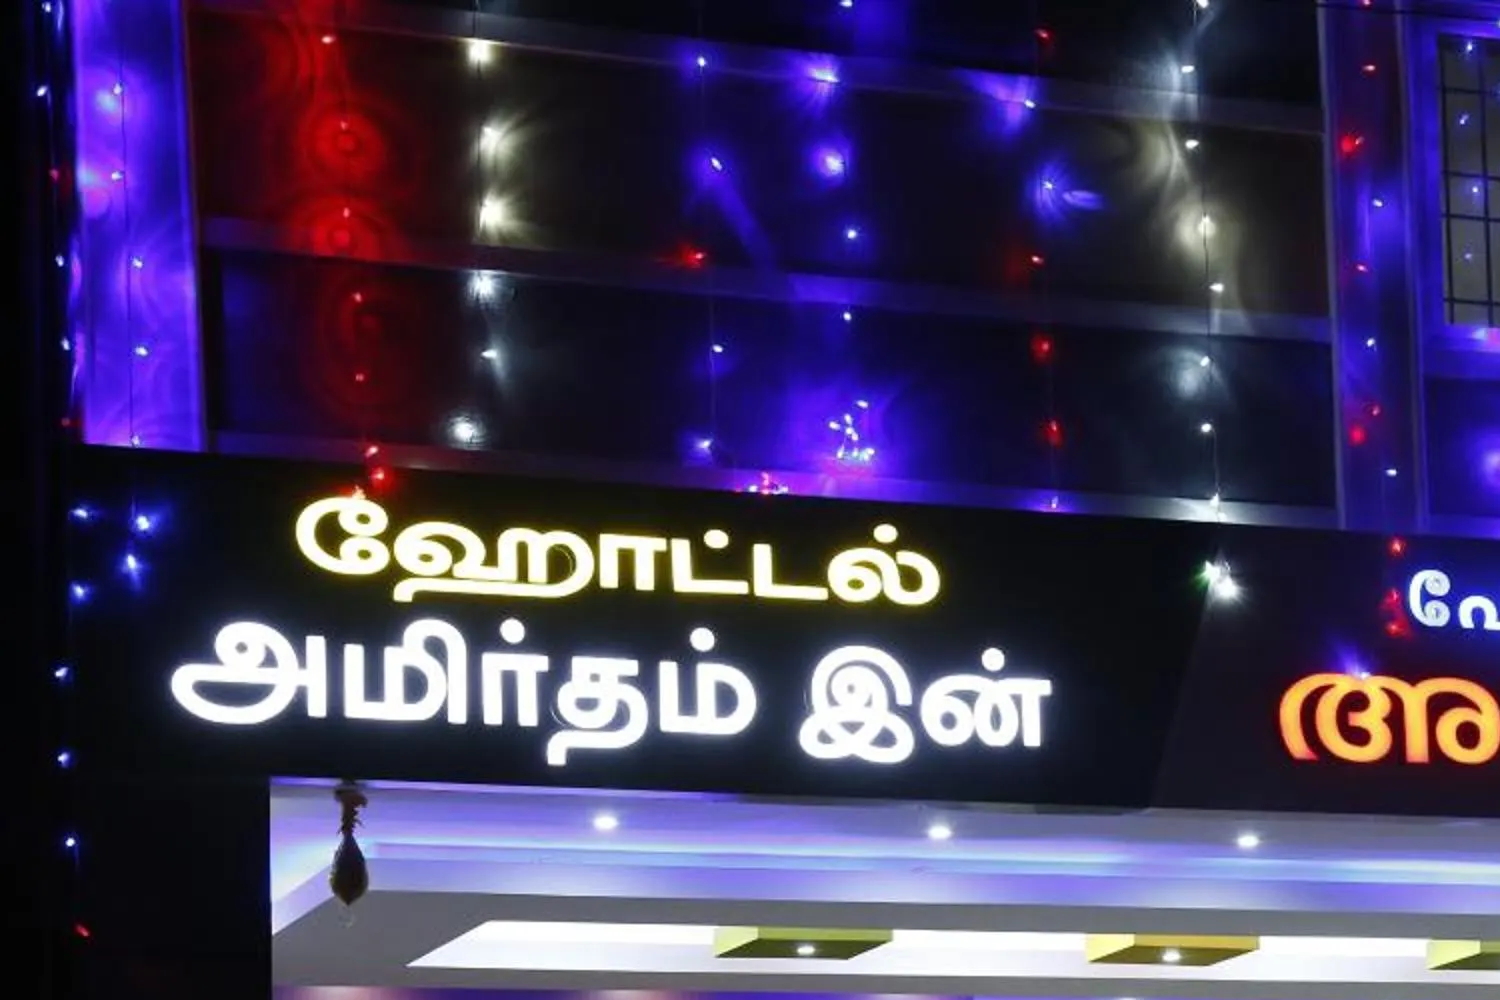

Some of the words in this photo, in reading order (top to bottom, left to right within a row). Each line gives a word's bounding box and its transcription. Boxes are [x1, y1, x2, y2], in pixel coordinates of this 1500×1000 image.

[294, 494, 942, 606] ஹோட்டல்
[170, 617, 758, 767] அமிர்தம்
[797, 644, 1053, 765] இன்
